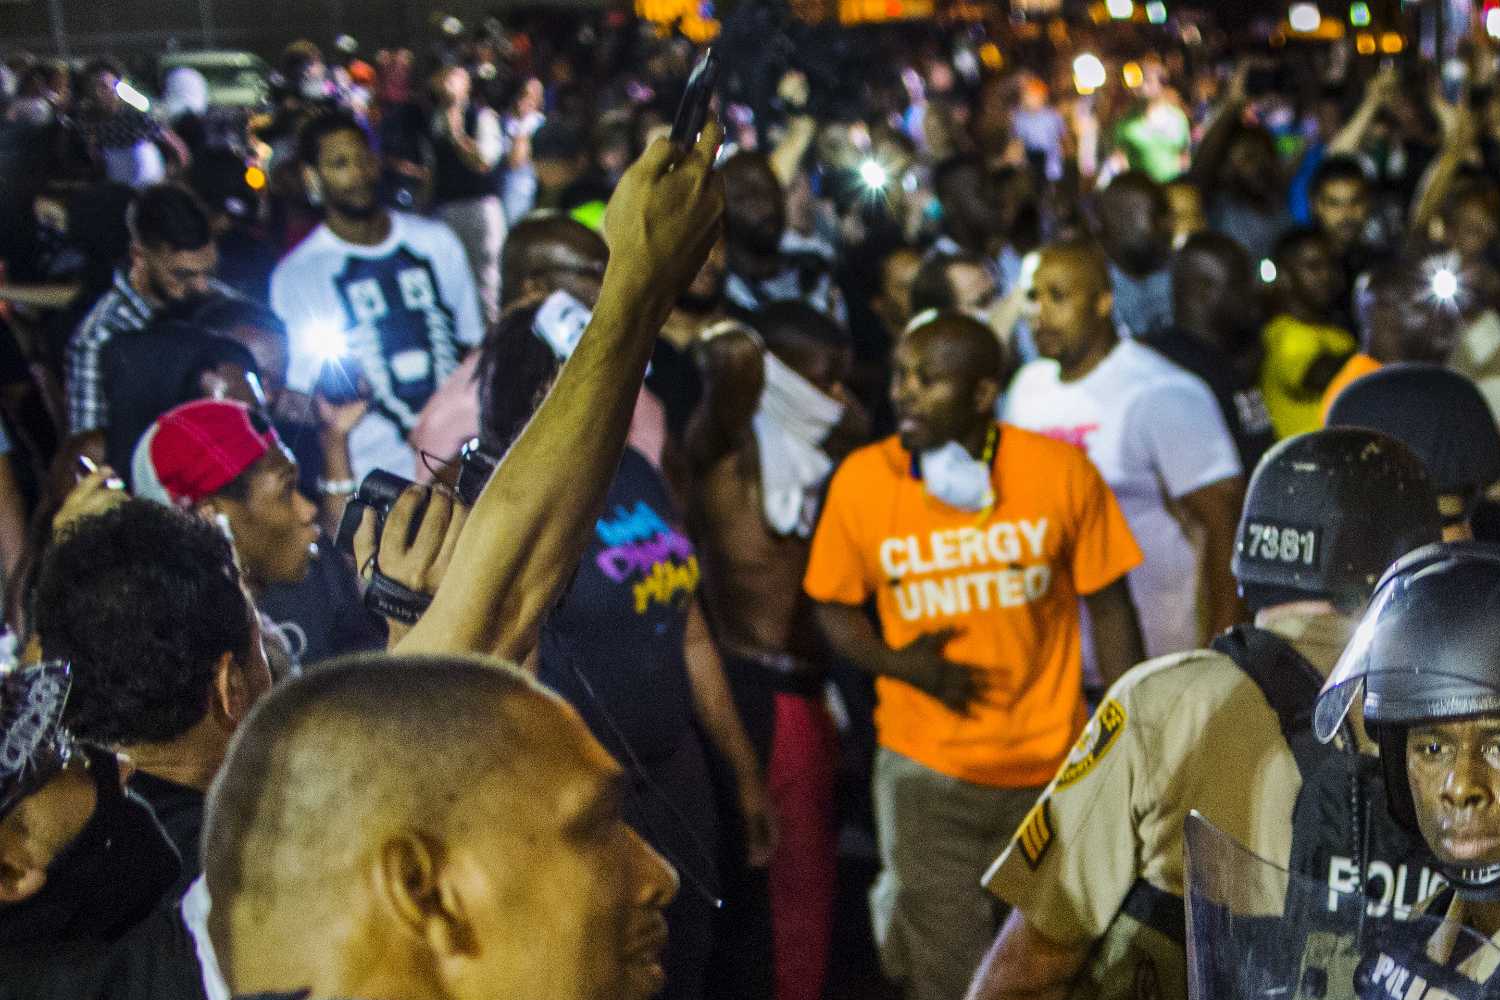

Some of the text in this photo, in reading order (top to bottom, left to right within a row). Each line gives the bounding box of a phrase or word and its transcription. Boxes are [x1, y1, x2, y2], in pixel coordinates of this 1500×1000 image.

[879, 517, 1048, 578] CLERGY
[1248, 522, 1315, 566] 7381
[894, 565, 1051, 621] UNITED
